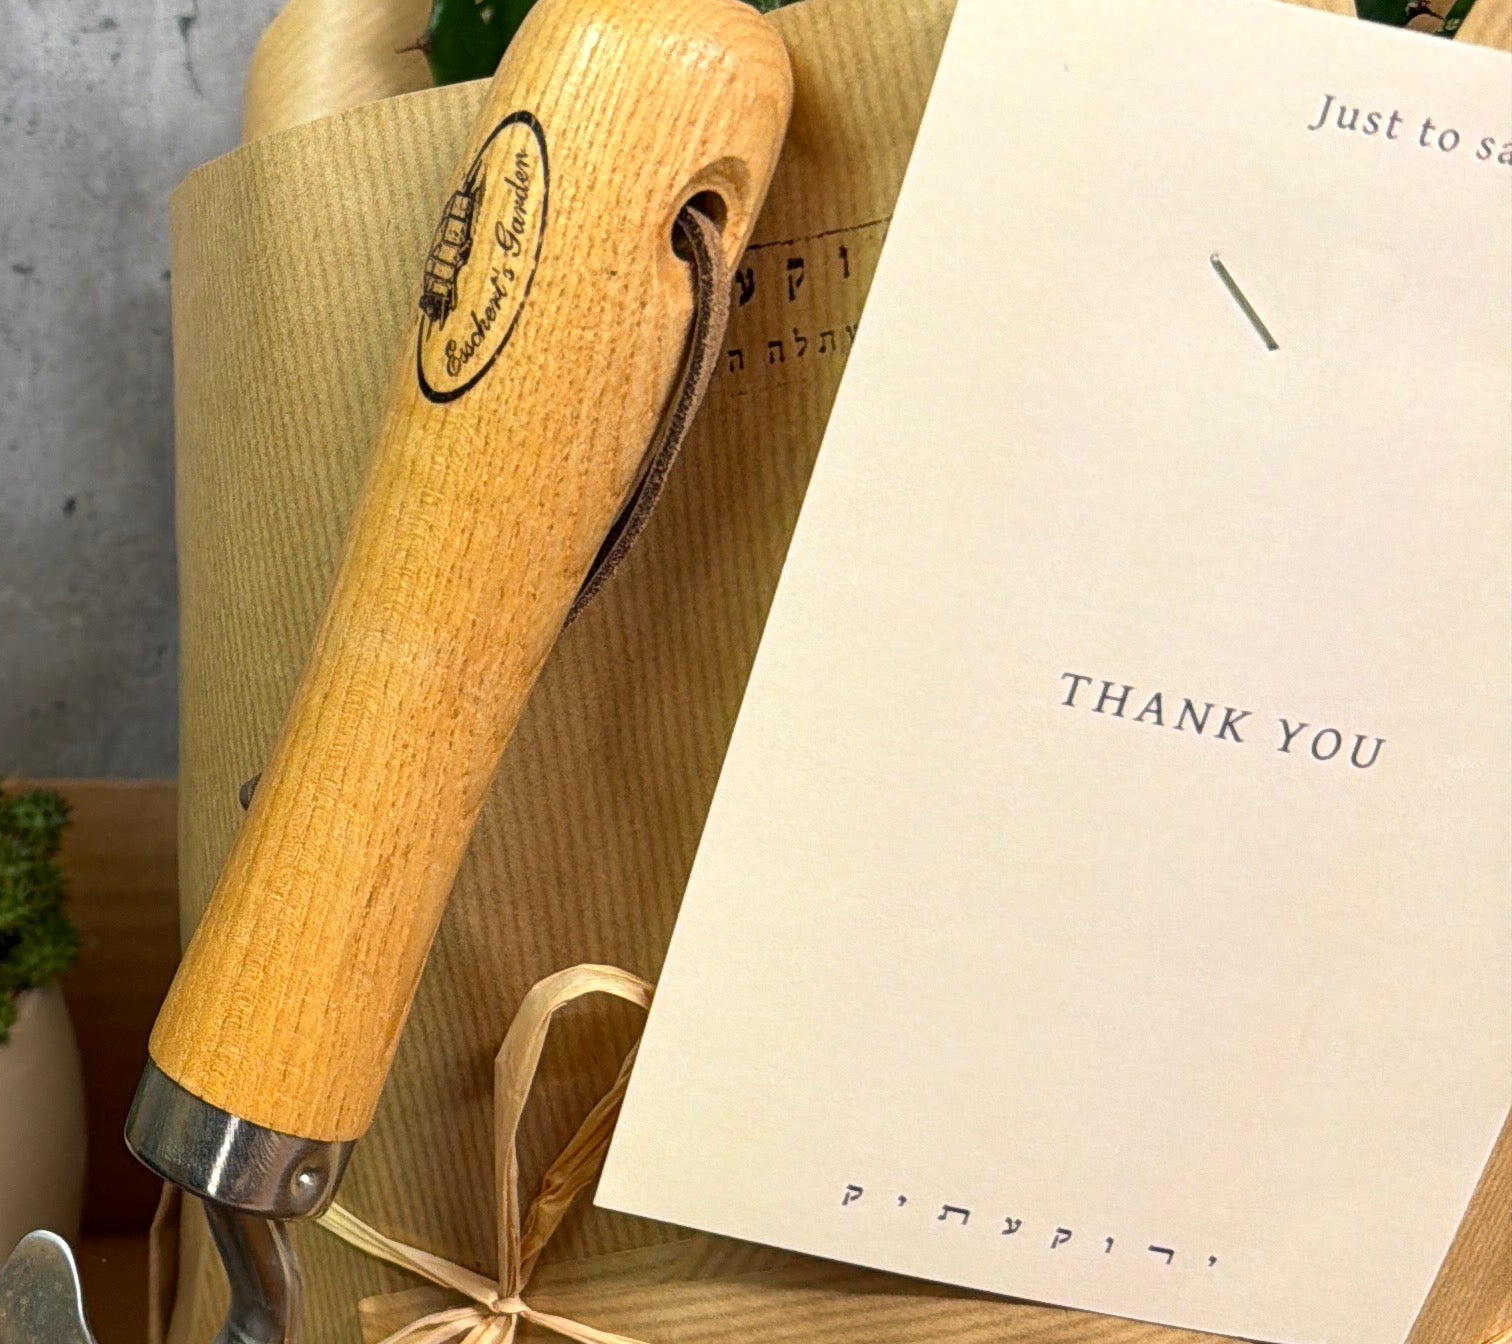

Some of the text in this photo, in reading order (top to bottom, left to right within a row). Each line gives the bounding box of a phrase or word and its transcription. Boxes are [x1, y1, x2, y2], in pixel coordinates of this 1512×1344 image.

[1306, 93, 1404, 141] Just
[1418, 116, 1462, 154] to
[444, 150, 531, 378] Esschert's Garden
[1060, 671, 1388, 770] THANK YOU
[841, 1182, 1219, 1269] ירוקעתיק
